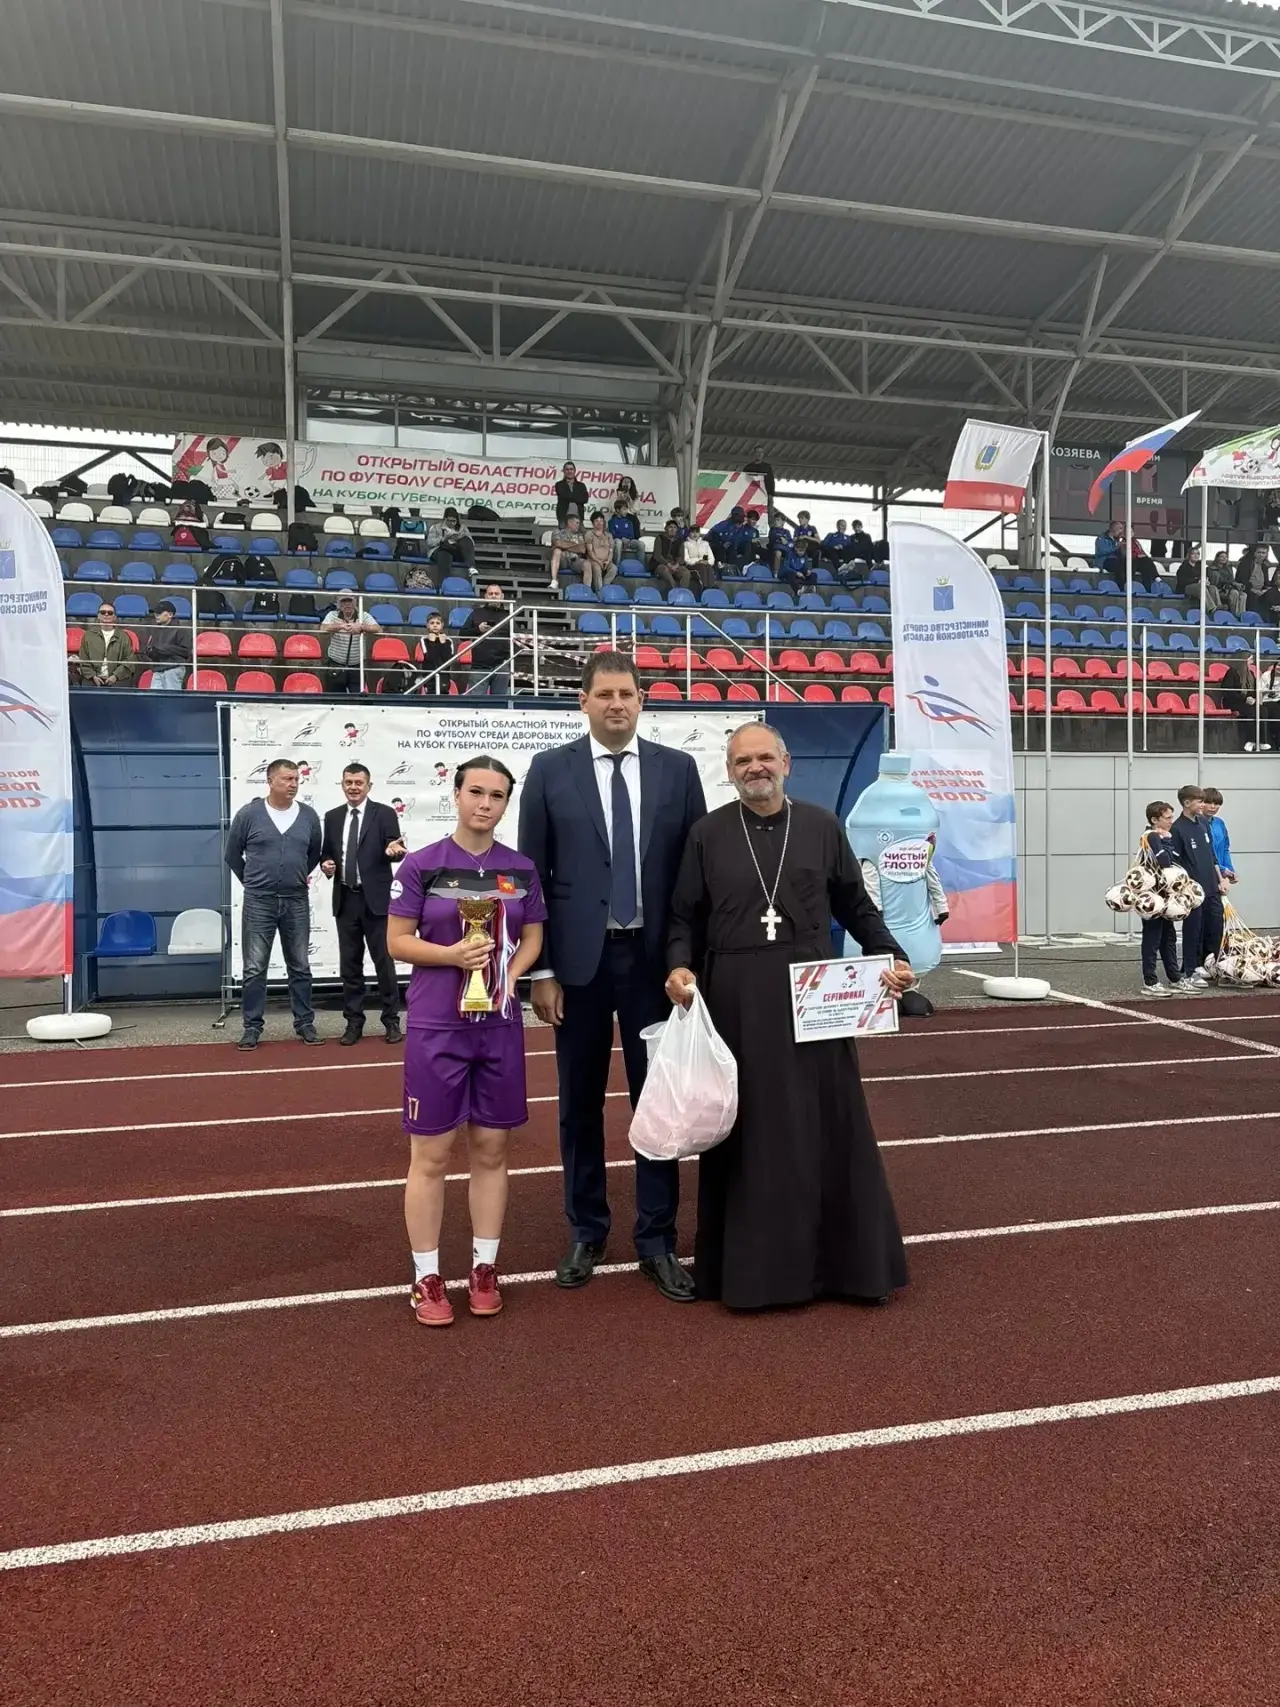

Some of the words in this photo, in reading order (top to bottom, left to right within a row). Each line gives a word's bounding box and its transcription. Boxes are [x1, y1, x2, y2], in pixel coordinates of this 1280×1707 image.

[357, 454, 455, 472] ОТКРЫТЫЙ
[458, 462, 557, 480] ОБЛАСТНОЙ
[321, 469, 346, 482] ПО
[349, 471, 430, 488] ФУТБОЛУ
[433, 476, 489, 492] СРЕДИ
[491, 481, 558, 496] ДВОРОВ
[312, 488, 334, 498] НА
[336, 489, 387, 500] КУБОК
[391, 492, 493, 509] ГУБЕРНАТОРА
[1136, 497, 1163, 505] ВРЕМЯ
[439, 718, 488, 728] ОТКРЫТЫЙ
[491, 719, 548, 729] ОБЛАСТНОЙ
[550, 721, 583, 729] ТУРНИР
[416, 729, 431, 738] ПО
[434, 730, 476, 739] ФУТБОЛУ
[479, 731, 510, 740] СРЕДИ
[512, 731, 563, 740] ДВОРОВЫХ
[397, 741, 411, 749] НА
[414, 740, 445, 749] КУБОК
[448, 741, 509, 750] ГУБЕРНАТОРА
[823, 989, 866, 1002] СЕРТИФИКАТ
